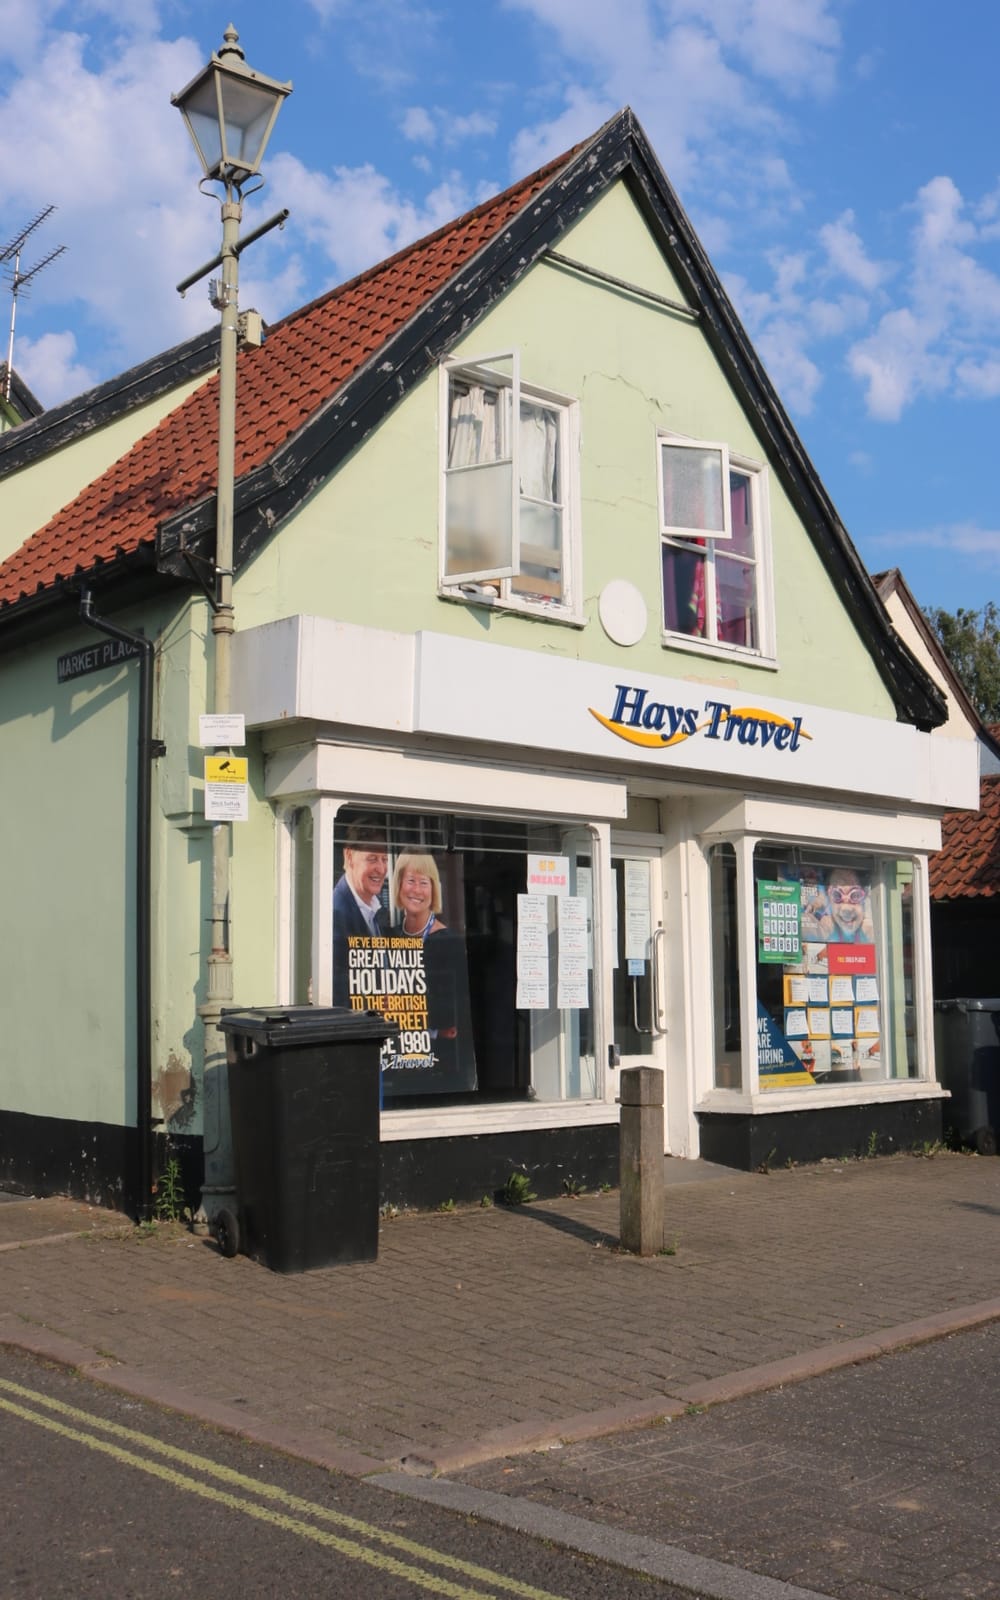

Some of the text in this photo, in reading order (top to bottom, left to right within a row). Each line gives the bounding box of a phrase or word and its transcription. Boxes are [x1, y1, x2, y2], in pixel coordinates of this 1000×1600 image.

[58, 647, 100, 677] MARKET
[608, 684, 803, 753] Hays Travel
[347, 936, 424, 949] WE'VE BEEN BRINGING
[348, 949, 425, 968] GREAT VALUE
[348, 969, 427, 995] HOLIDAYS
[350, 995, 428, 1011] TO THE BRITISH
[397, 1031, 431, 1054] 1980
[391, 1052, 435, 1070] Travel
